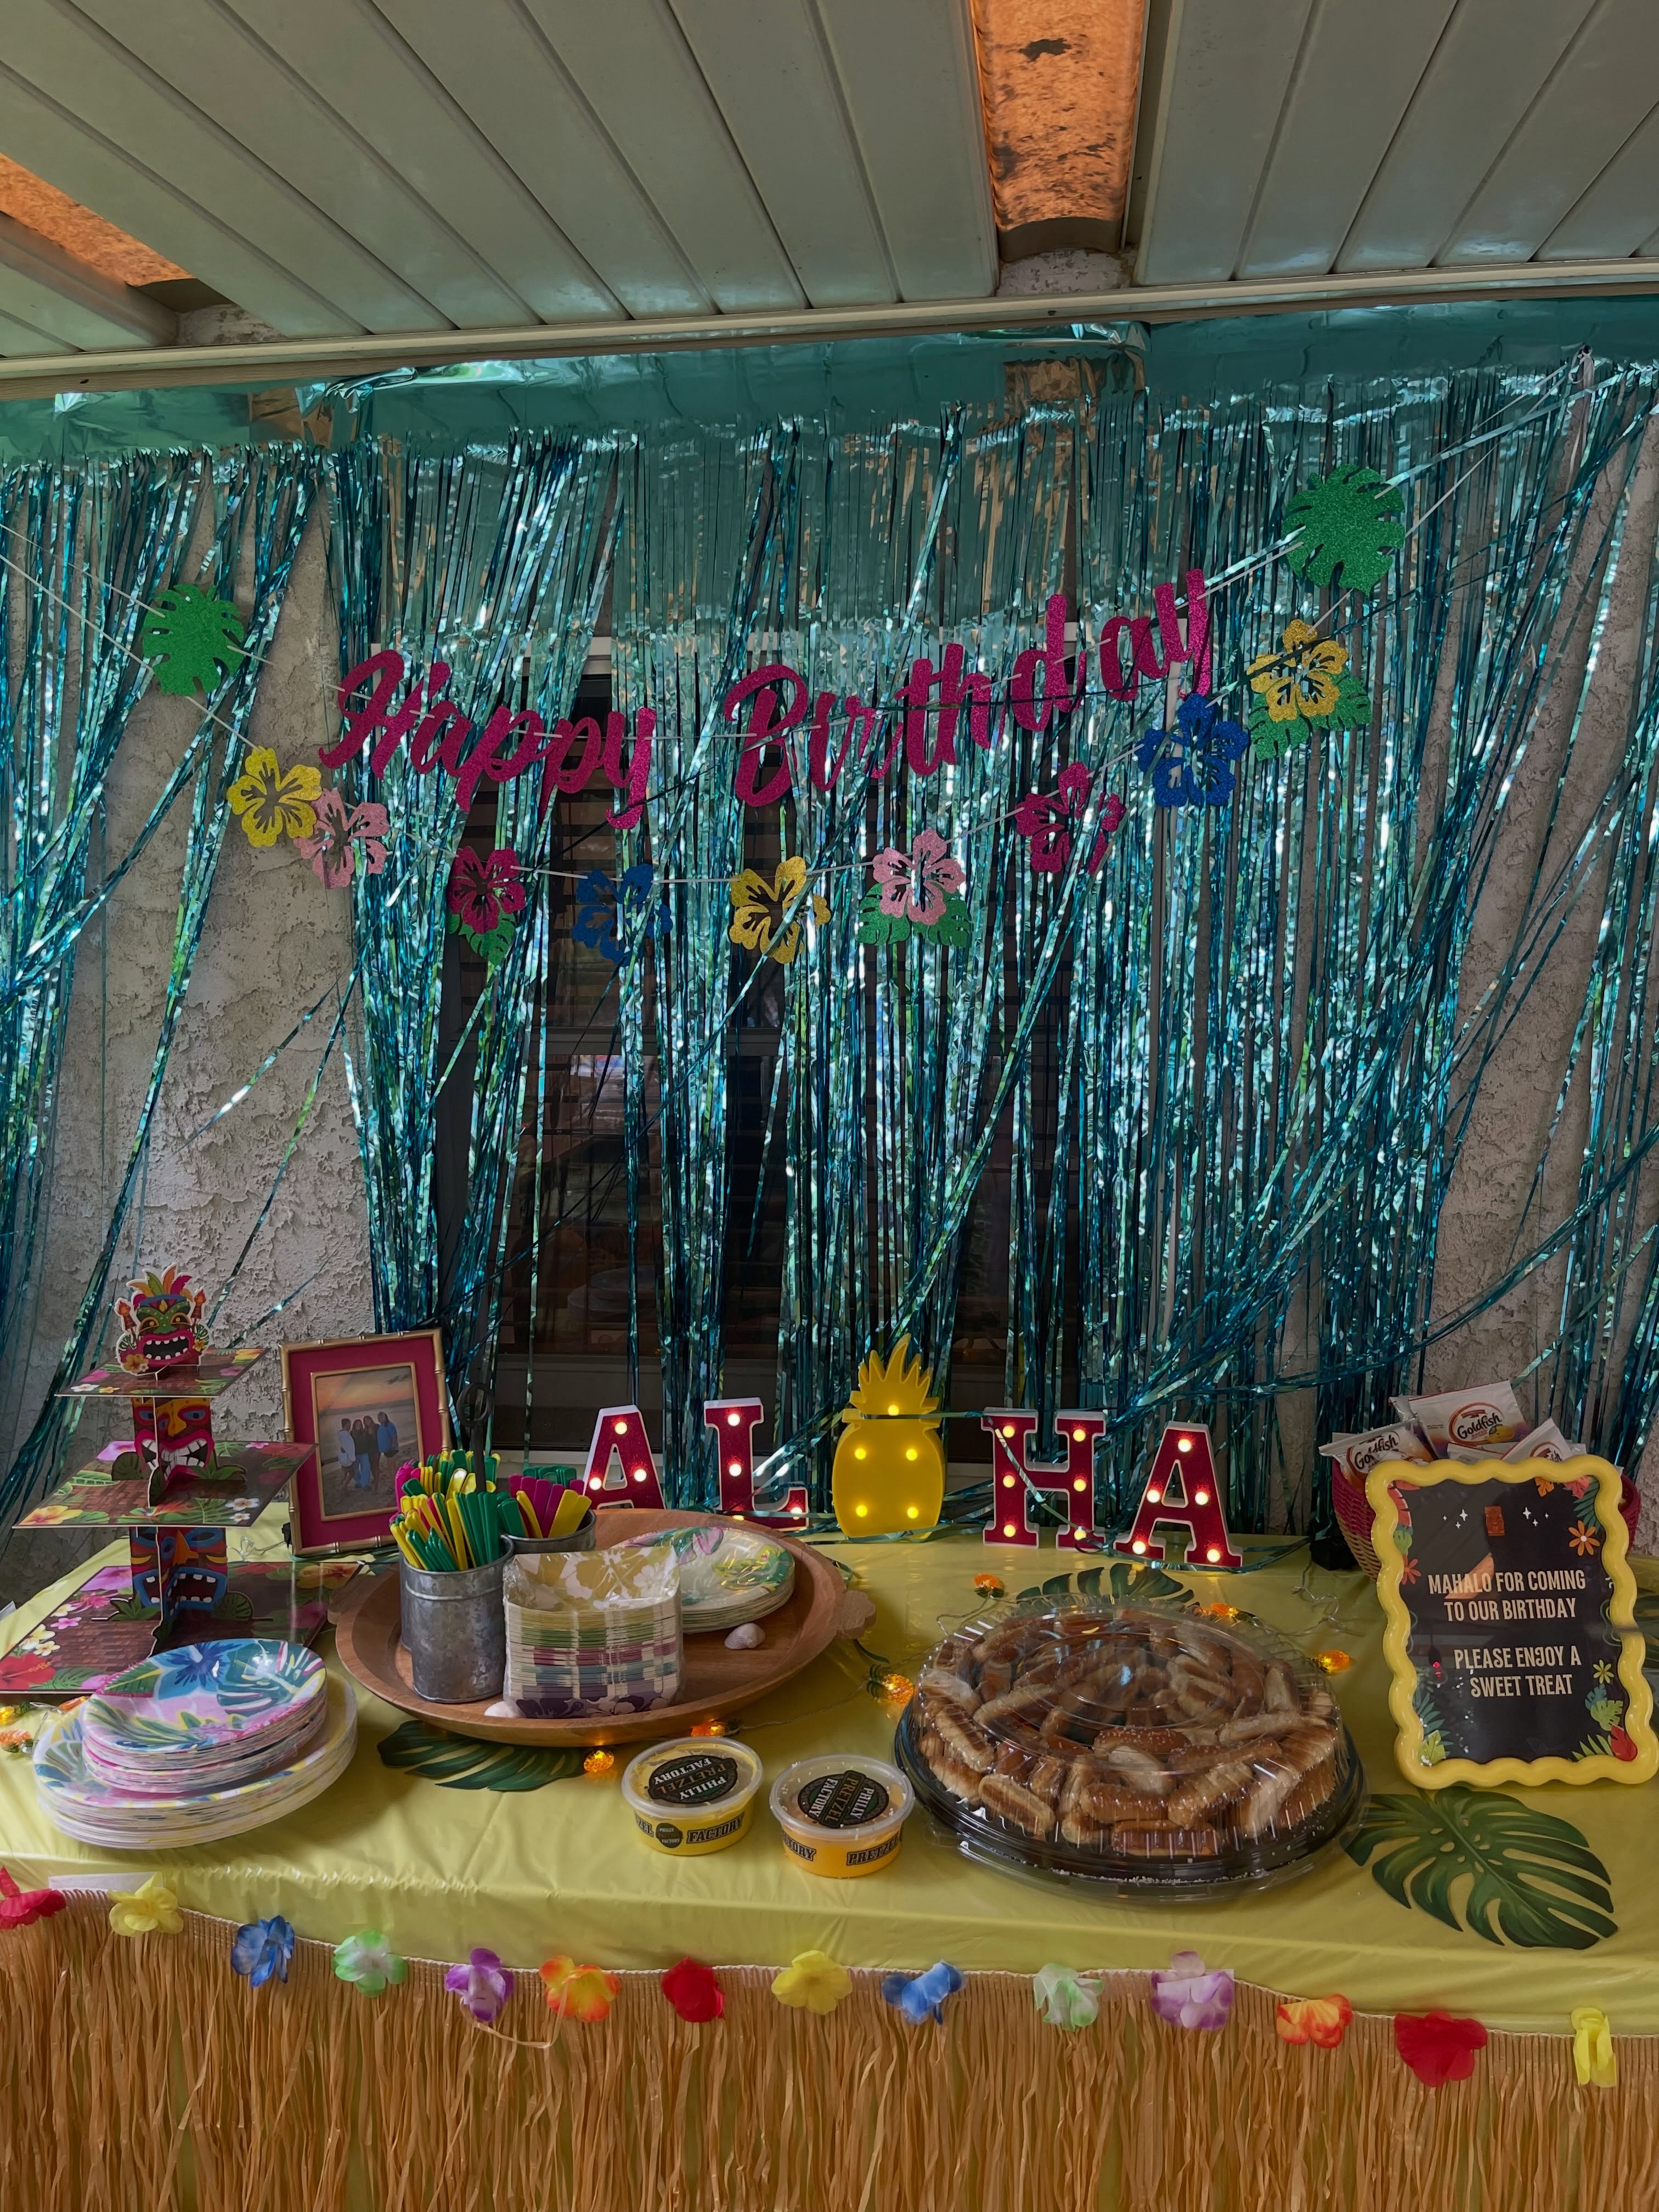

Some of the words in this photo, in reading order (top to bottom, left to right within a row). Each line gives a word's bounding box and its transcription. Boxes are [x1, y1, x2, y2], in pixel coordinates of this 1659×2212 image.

[318, 650, 656, 830] Happy
[723, 568, 1211, 807] Birthday
[1457, 1412, 1502, 1440] Goldfish
[1355, 1435, 1398, 1469] Goldfish
[1427, 1572, 1492, 1594] MAHALO
[1495, 1571, 1525, 1592] FOR
[1527, 1570, 1585, 1590] COMING
[1444, 1601, 1464, 1621] TO
[1468, 1600, 1499, 1620] OUR
[1502, 1598, 1576, 1620] BIRTHDAY
[1454, 1647, 1513, 1669] PLEASE
[1515, 1646, 1564, 1667] ENJOY
[1571, 1645, 1582, 1666] A
[1470, 1675, 1521, 1697] SWEET
[1525, 1674, 1573, 1695] TREAT
[654, 1758, 712, 1785] FACTORY
[657, 1763, 726, 1794] PRETZEL
[680, 1776, 727, 1800] PHILLY
[809, 1778, 839, 1817] FACTORY
[825, 1777, 859, 1822] PRETZEL
[850, 1787, 875, 1819] PHILLY
[687, 1814, 744, 1843] FACTORY
